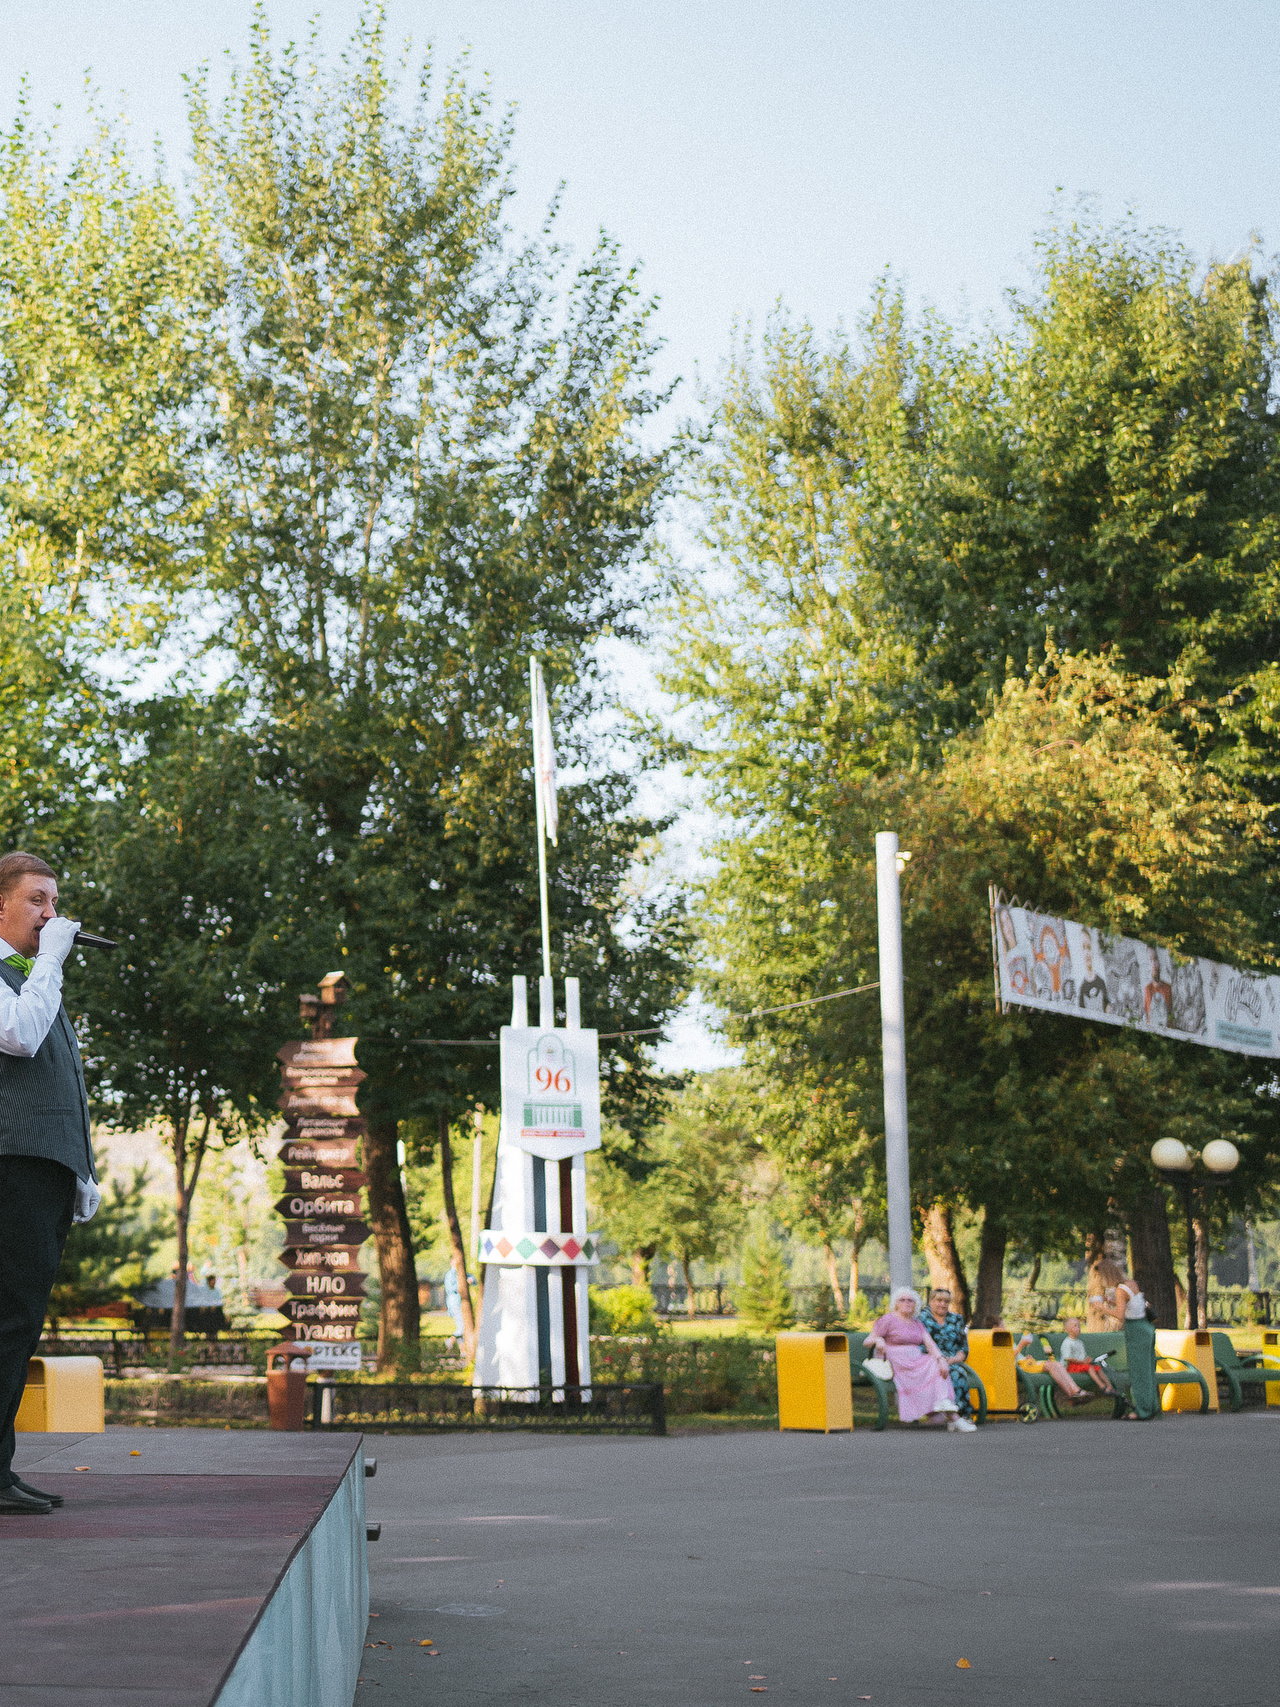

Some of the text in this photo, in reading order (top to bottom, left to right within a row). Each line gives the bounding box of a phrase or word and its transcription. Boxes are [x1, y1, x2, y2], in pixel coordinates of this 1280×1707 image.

[535, 1066, 571, 1093] 96
[301, 1171, 344, 1189] Вальс
[290, 1196, 355, 1217] Орбита
[295, 1249, 350, 1266] Хип-хоп
[306, 1275, 346, 1294] НЛО
[289, 1300, 359, 1320] Траффик
[292, 1322, 354, 1341] Туалет
